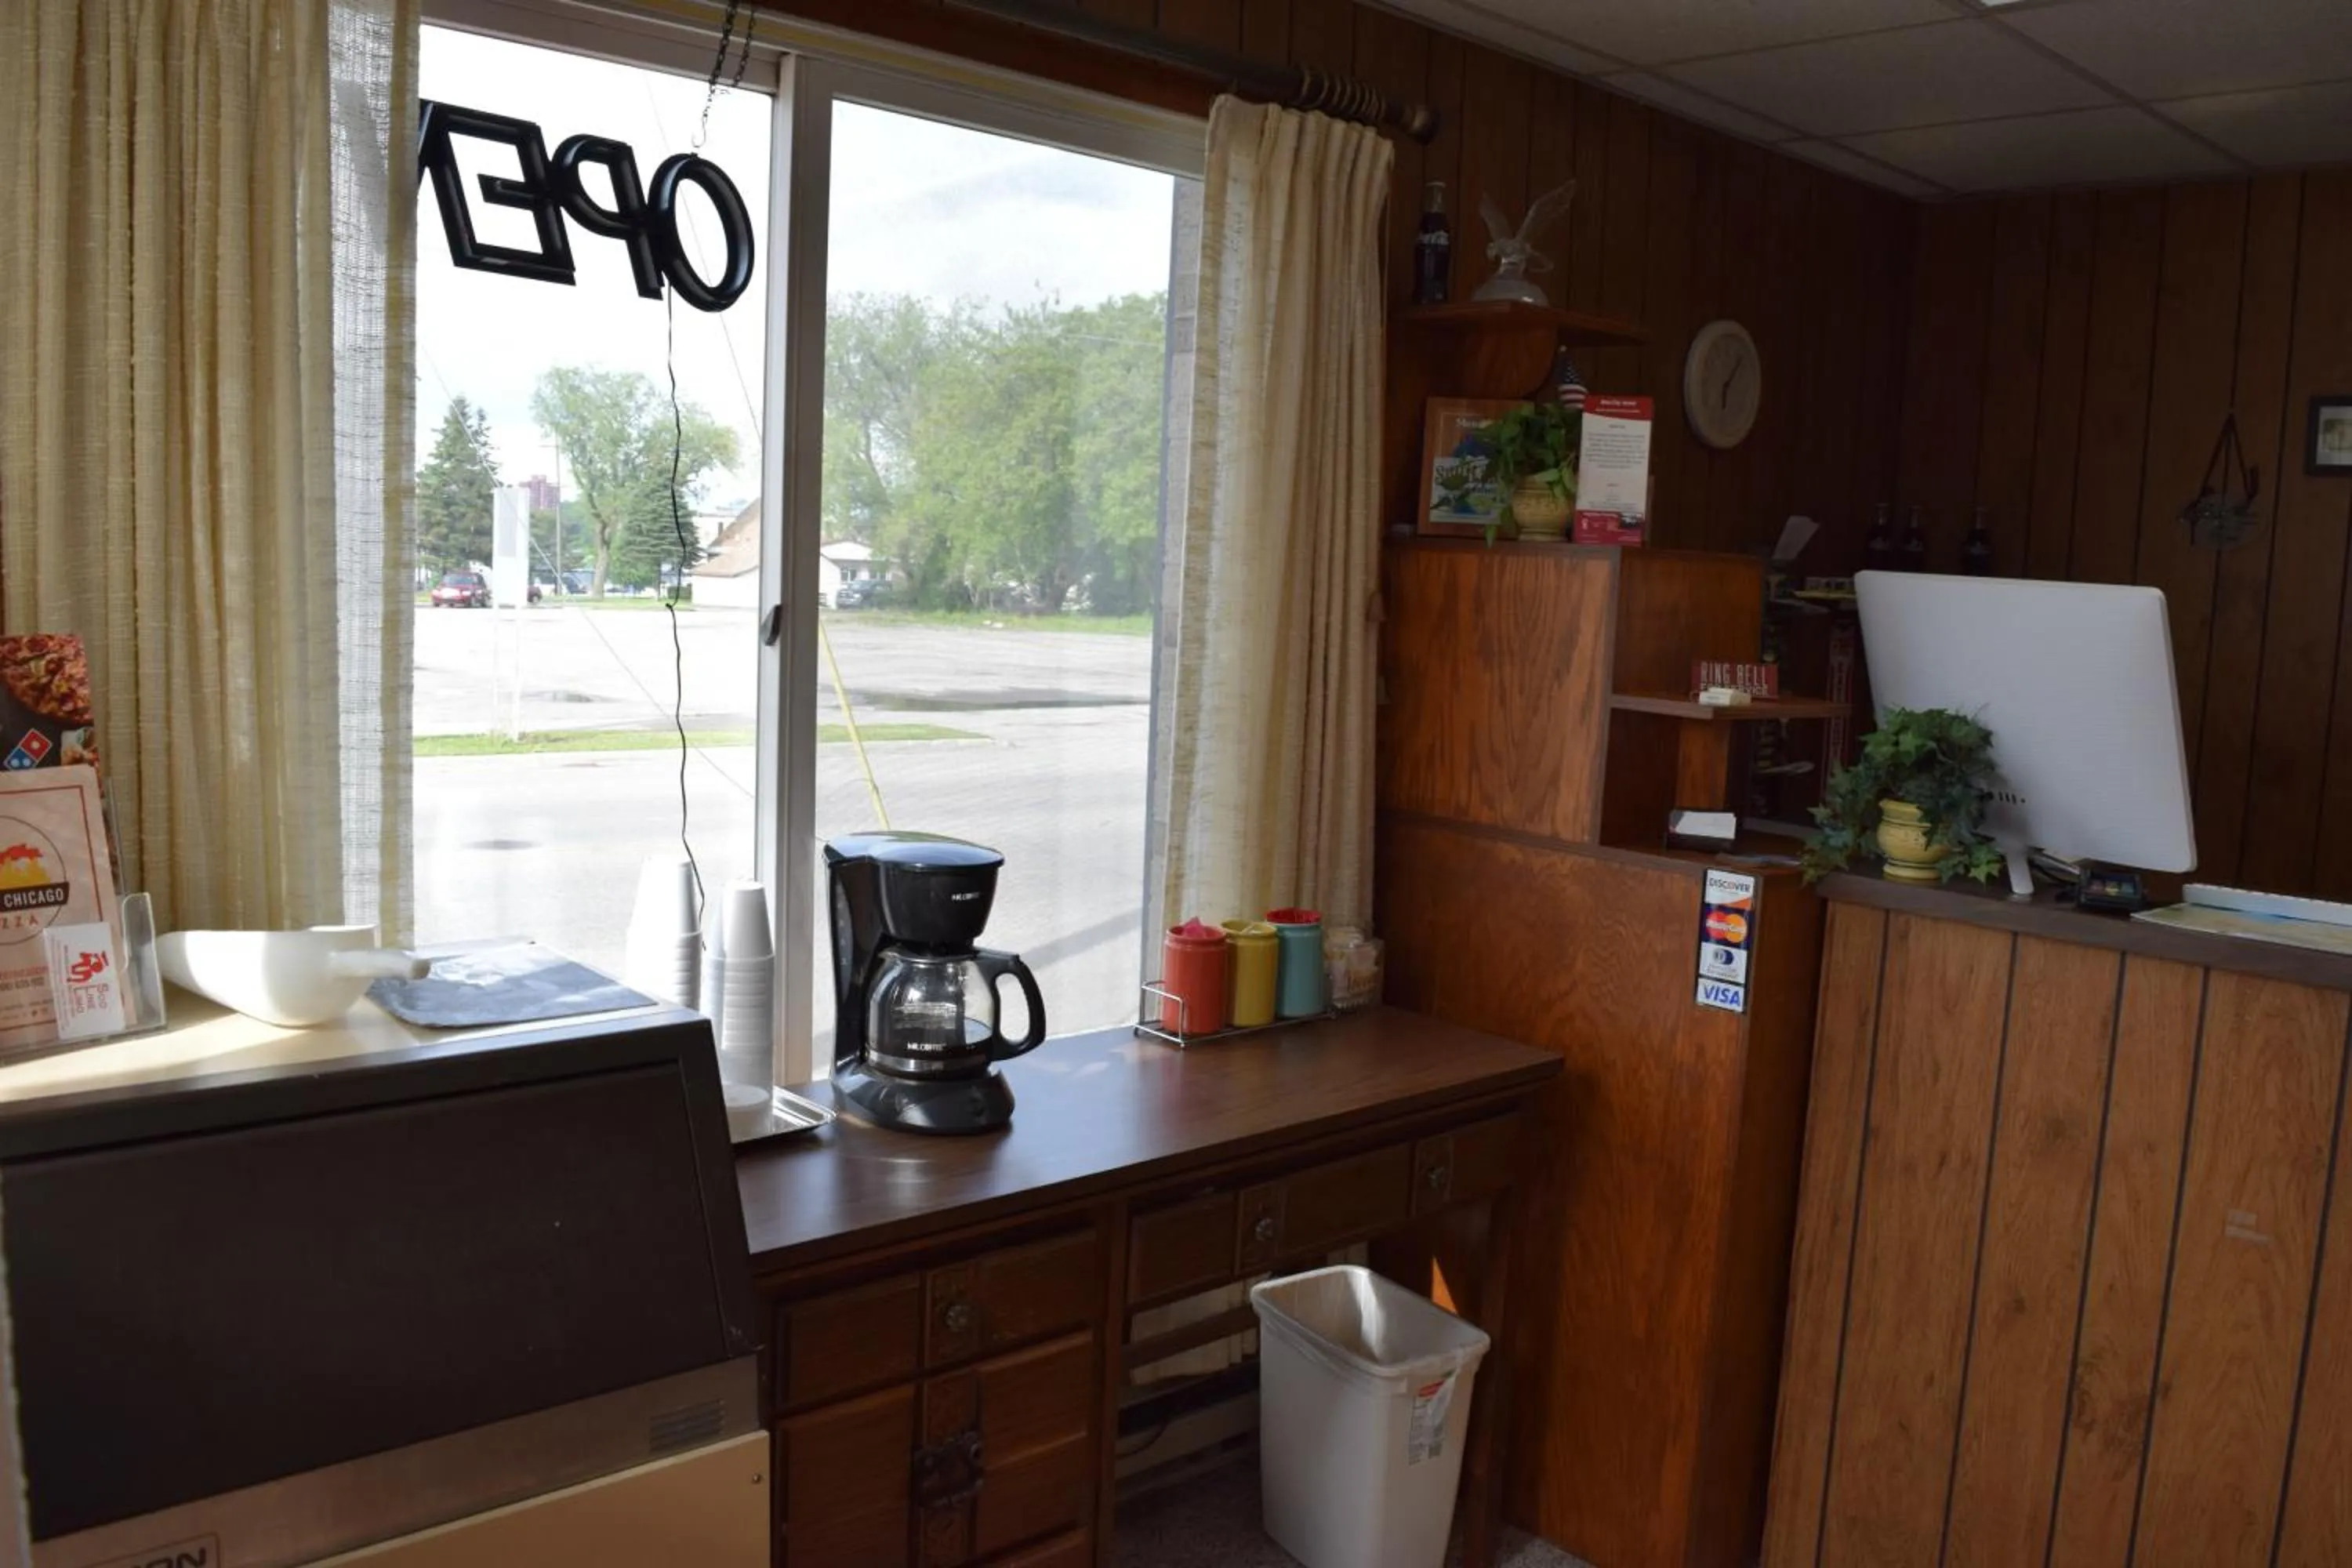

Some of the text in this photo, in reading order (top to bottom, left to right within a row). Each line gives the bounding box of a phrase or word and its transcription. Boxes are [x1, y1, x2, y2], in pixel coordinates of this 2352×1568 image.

[1700, 661, 1730, 684] RING
[1737, 664, 1768, 687] BELL
[1708, 877, 1751, 893] DISCOVER
[3, 887, 64, 908] CHICAGO
[1703, 984, 1741, 1007] VISA
